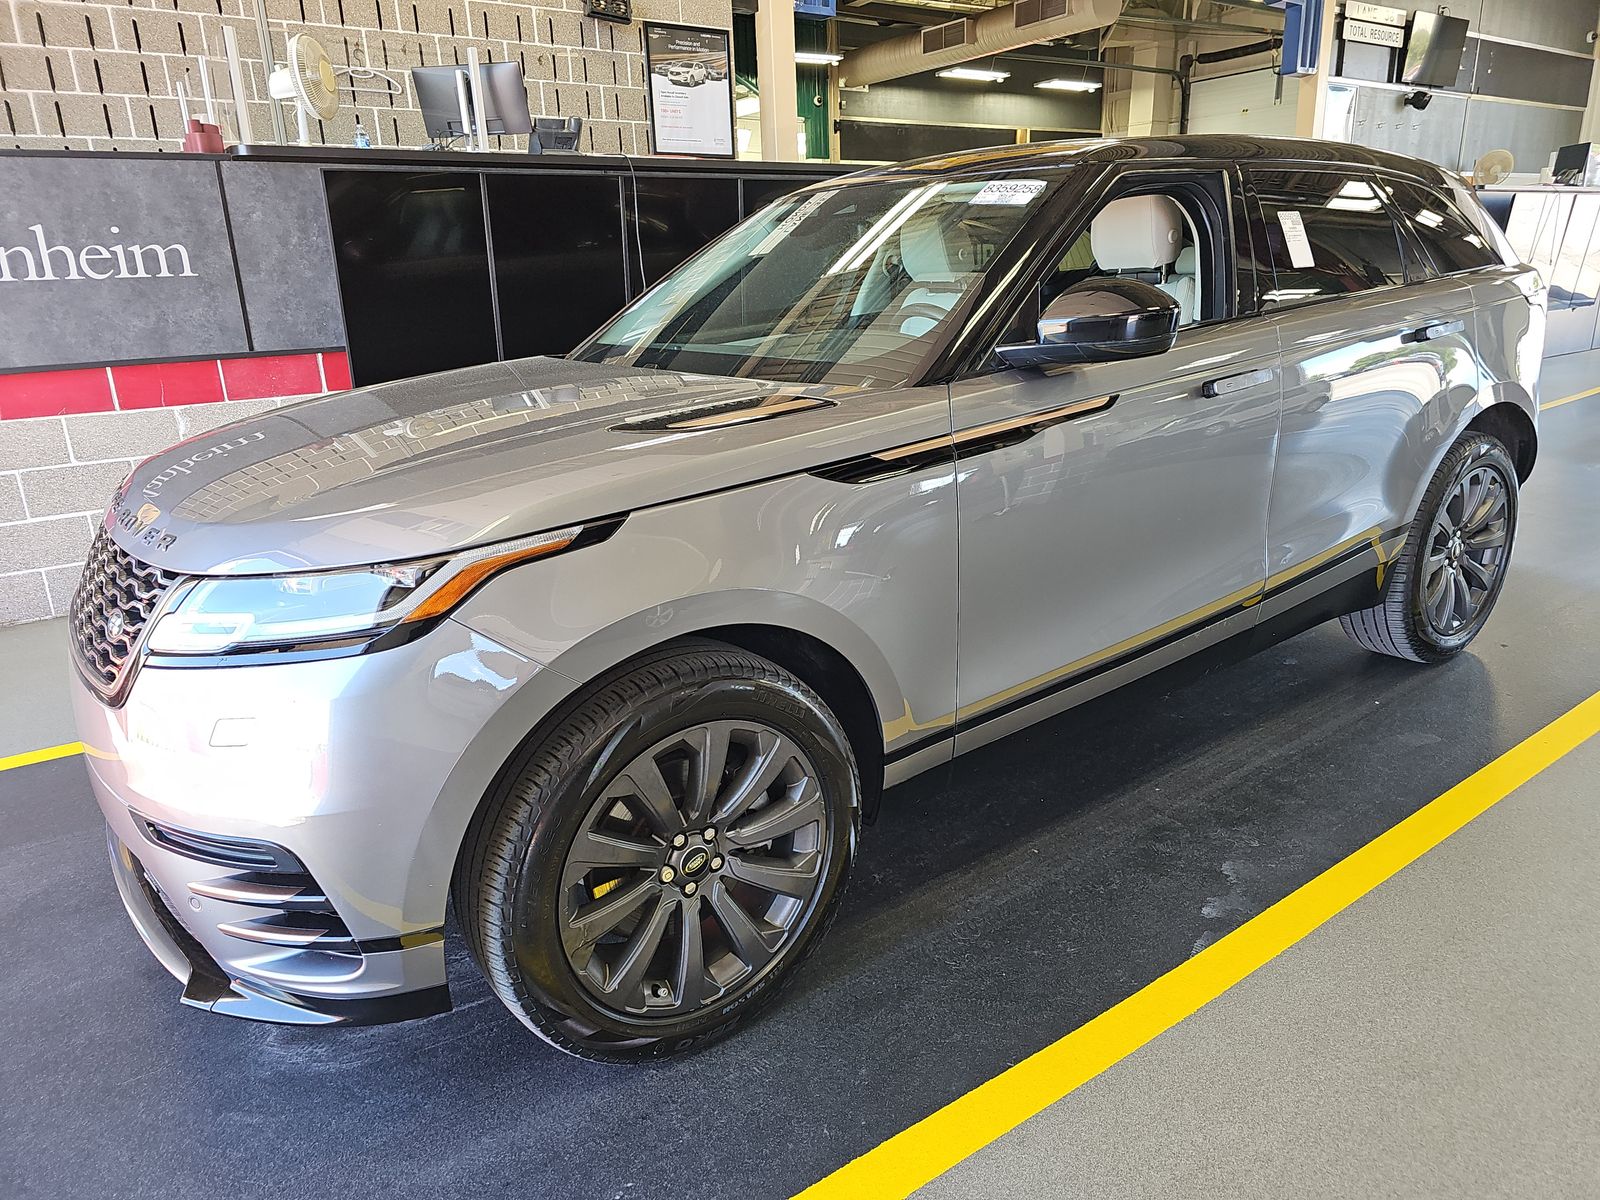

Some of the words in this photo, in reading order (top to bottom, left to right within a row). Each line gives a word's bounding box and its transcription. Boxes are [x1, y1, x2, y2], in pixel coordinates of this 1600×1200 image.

[1350, 25, 1367, 38] TOTAL
[1370, 28, 1400, 43] RESOURCE
[117, 508, 177, 552] ROVER
